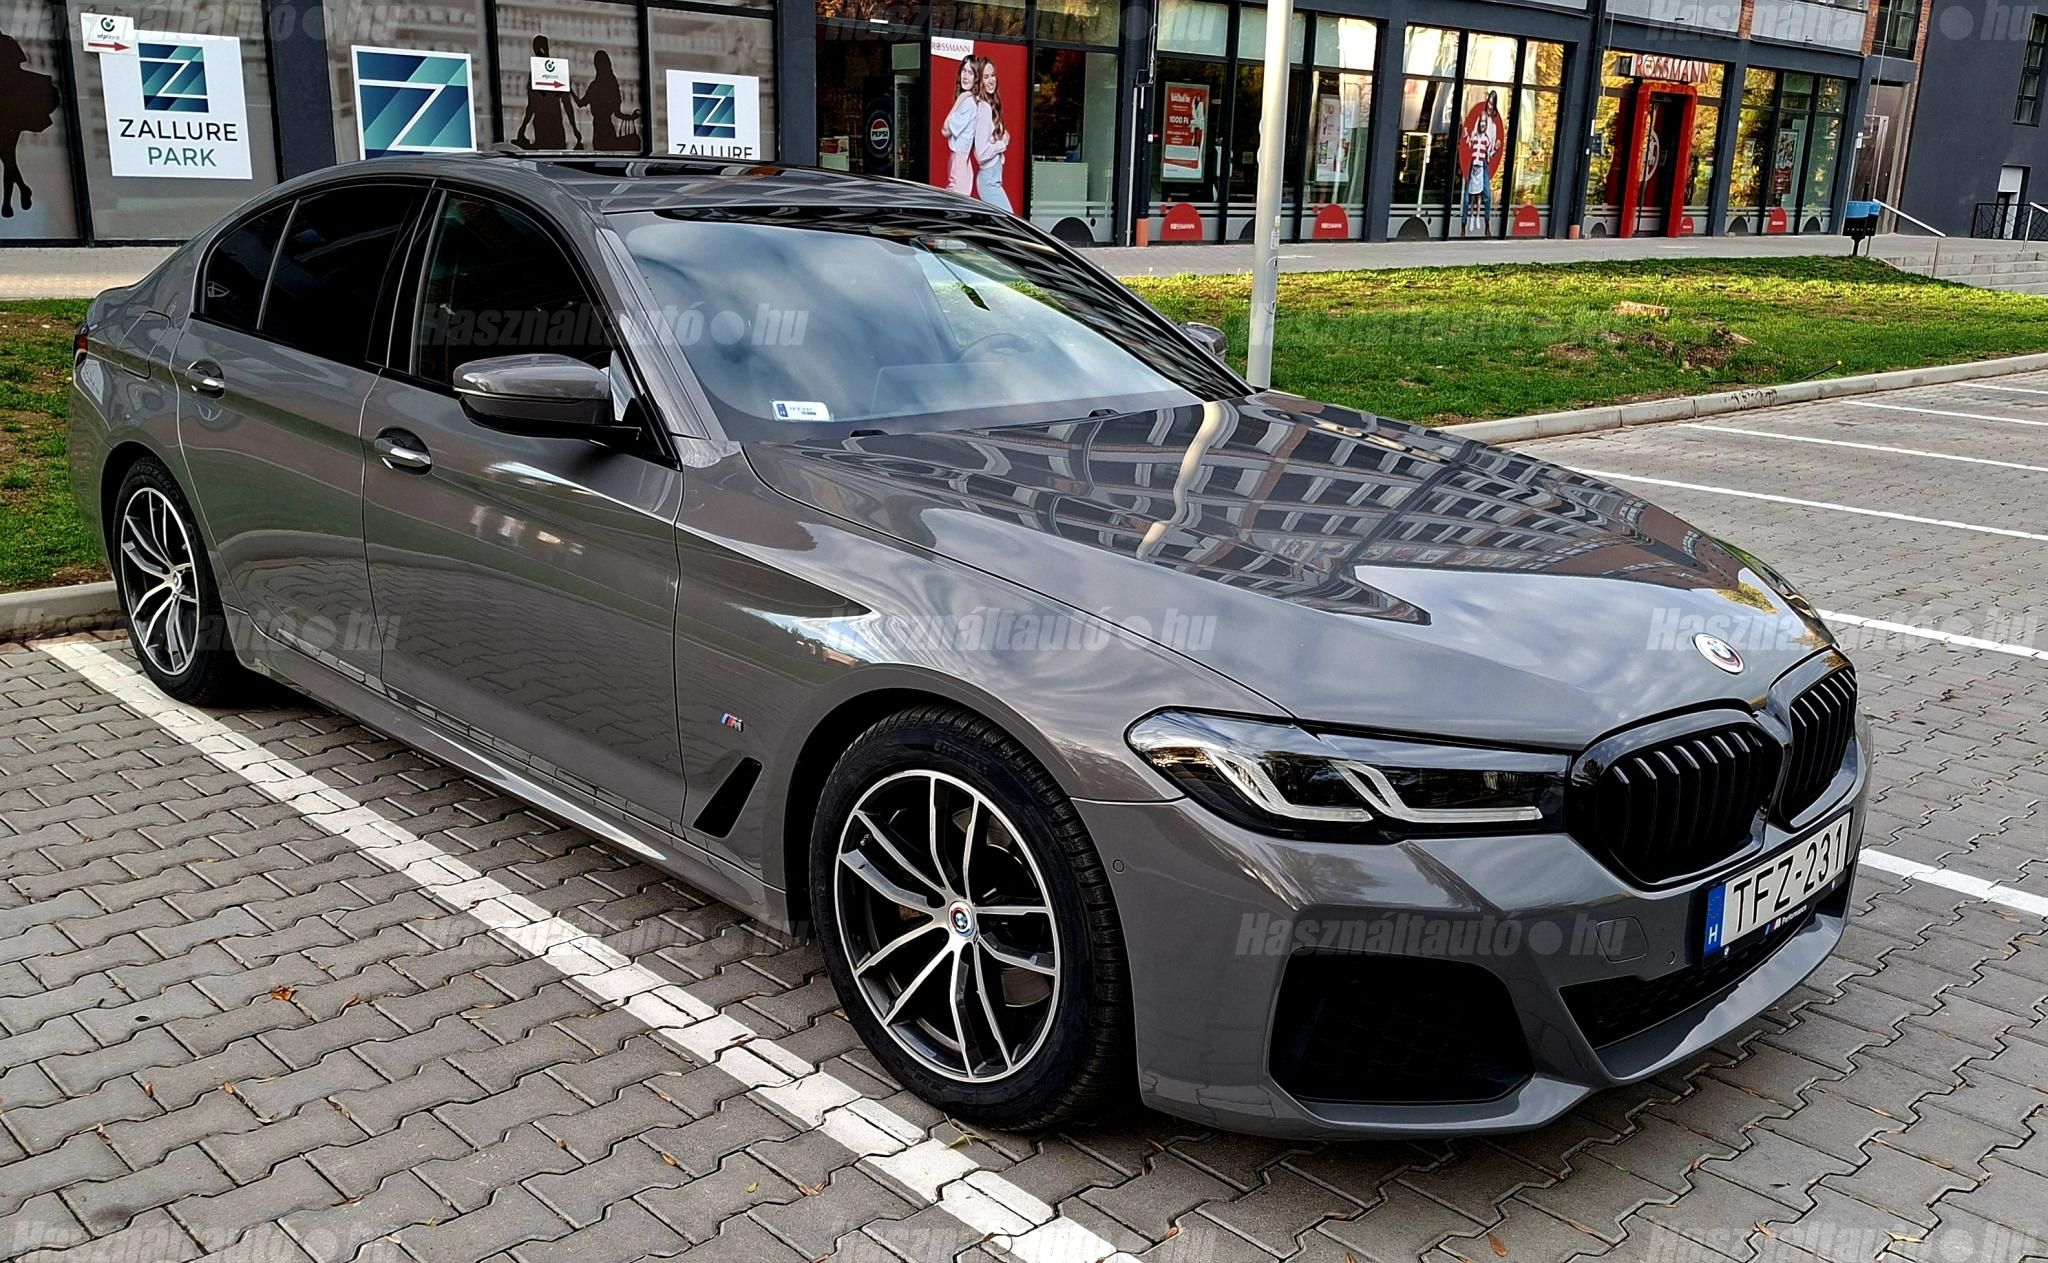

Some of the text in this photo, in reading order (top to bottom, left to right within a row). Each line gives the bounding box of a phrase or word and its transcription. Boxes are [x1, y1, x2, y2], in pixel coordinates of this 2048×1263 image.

[1631, 53, 1709, 84] ROSSMANN
[119, 119, 238, 142] ZALLURE
[148, 147, 216, 167] PARK
[1733, 824, 1843, 933] TFZ-231
[1708, 924, 1718, 945] H
